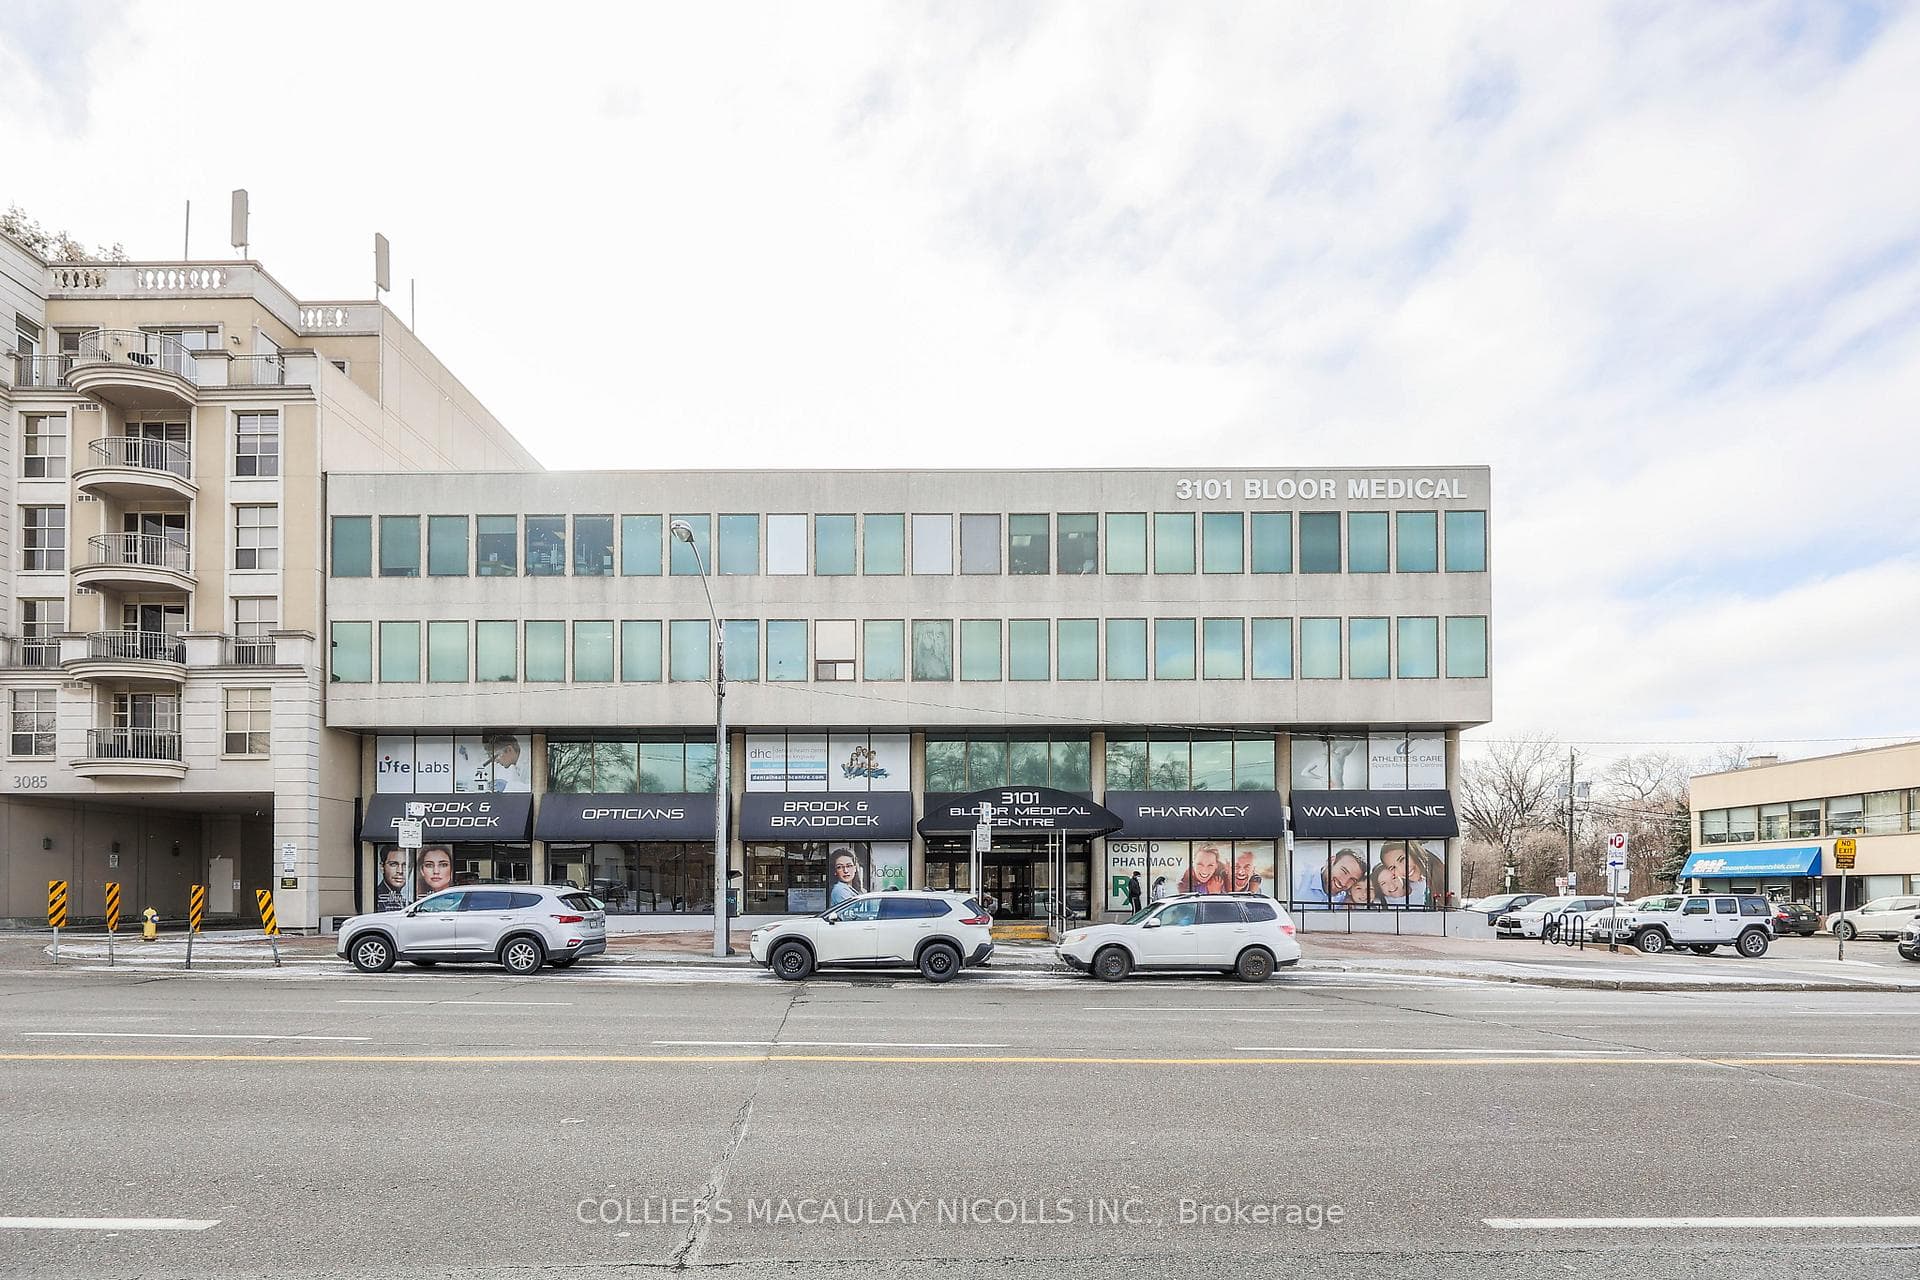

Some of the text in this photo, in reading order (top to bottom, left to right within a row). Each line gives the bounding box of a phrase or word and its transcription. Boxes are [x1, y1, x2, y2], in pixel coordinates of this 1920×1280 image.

[1176, 478, 1468, 500] 3101 BLOOR MEDICAL
[750, 748, 772, 759] dhc
[13, 775, 48, 789] 3085
[1001, 792, 1040, 805] 3101
[421, 802, 491, 812] ROOK &
[783, 801, 868, 812] BROOK &
[1014, 806, 1091, 816] MEDICAL
[1138, 806, 1249, 817] PHARMACY
[1302, 806, 1447, 817] WALK-IN CLINIC
[581, 808, 685, 820] OPTICIANS
[770, 815, 880, 827] BRADDOCK
[1112, 857, 1183, 867] PHARMACY
